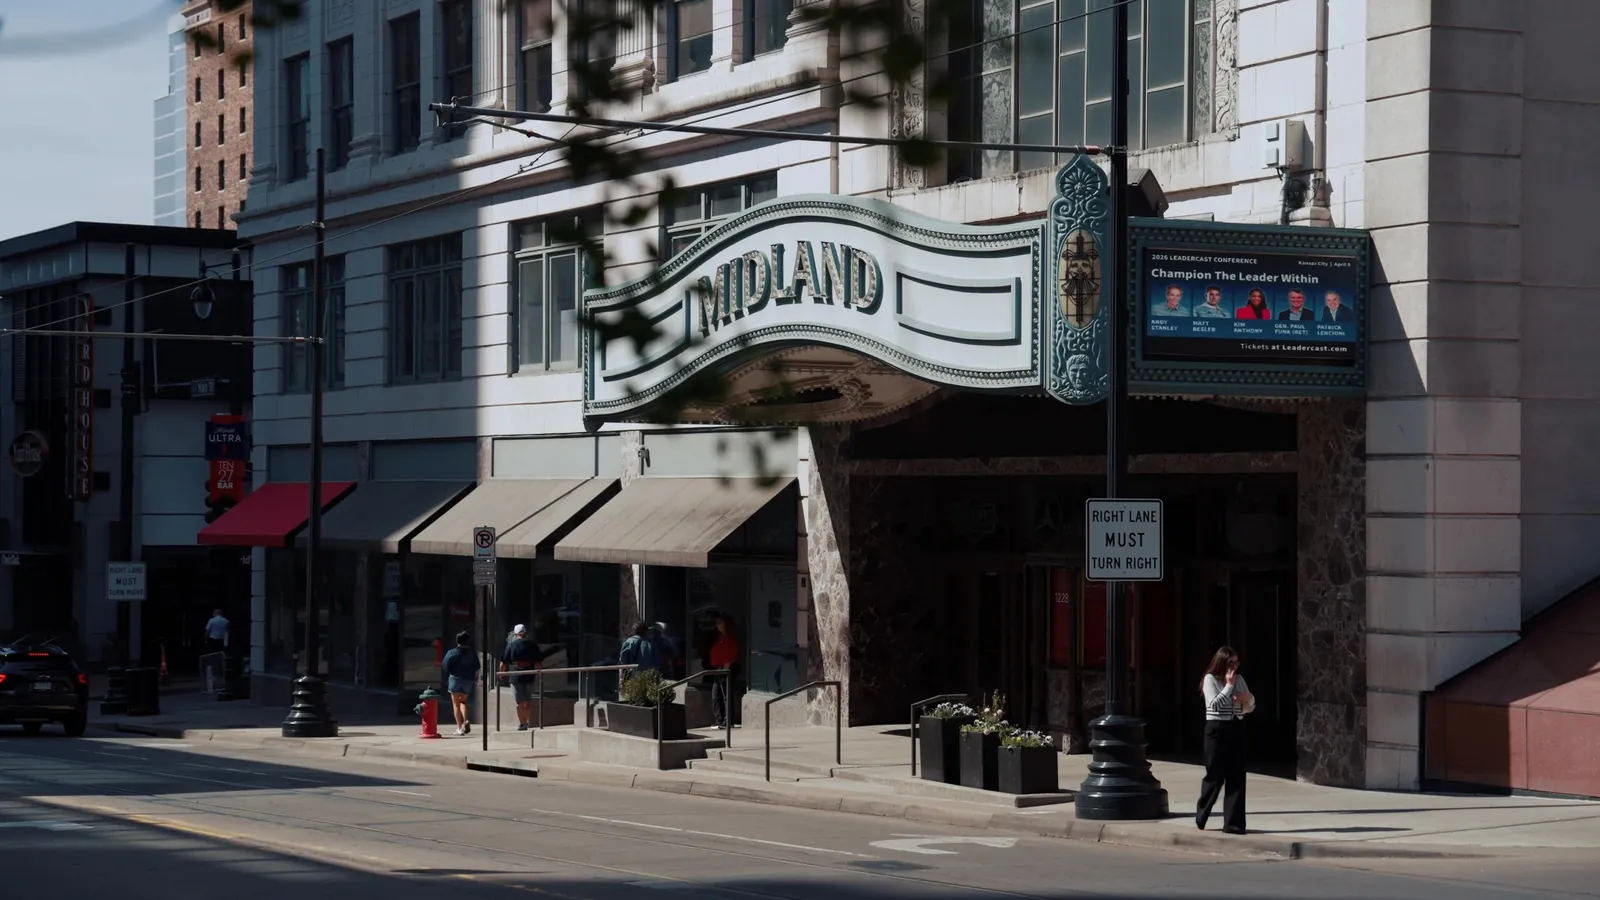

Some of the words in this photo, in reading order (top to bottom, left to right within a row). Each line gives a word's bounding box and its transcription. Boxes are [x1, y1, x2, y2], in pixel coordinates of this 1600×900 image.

[1169, 255, 1213, 263] LEADERCAST
[1213, 256, 1258, 264] CONFERENCE
[1151, 268, 1212, 281] Champion
[1214, 271, 1236, 281] The
[1239, 272, 1279, 282] Leader
[1281, 273, 1319, 283] Within
[698, 241, 883, 337] MIDLAND
[1240, 343, 1270, 351] Tickets
[1282, 344, 1348, 352] Leadercast.com
[82, 391, 90, 494] HOUSE
[208, 434, 242, 442] ULTRA
[218, 460, 235, 469] TEN
[218, 469, 234, 482] 27
[1092, 510, 1125, 523] RIGHT
[1129, 510, 1157, 523] LANE
[1105, 532, 1145, 548] MUST
[1092, 557, 1121, 569] TURN
[1125, 557, 1158, 569] RIGHT
[110, 566, 127, 574] RIGHT
[128, 566, 143, 574] LANE
[116, 577, 137, 586] MUST
[109, 588, 125, 596] TURN
[126, 588, 143, 596] RIGHT
[1055, 592, 1069, 603] 1228
